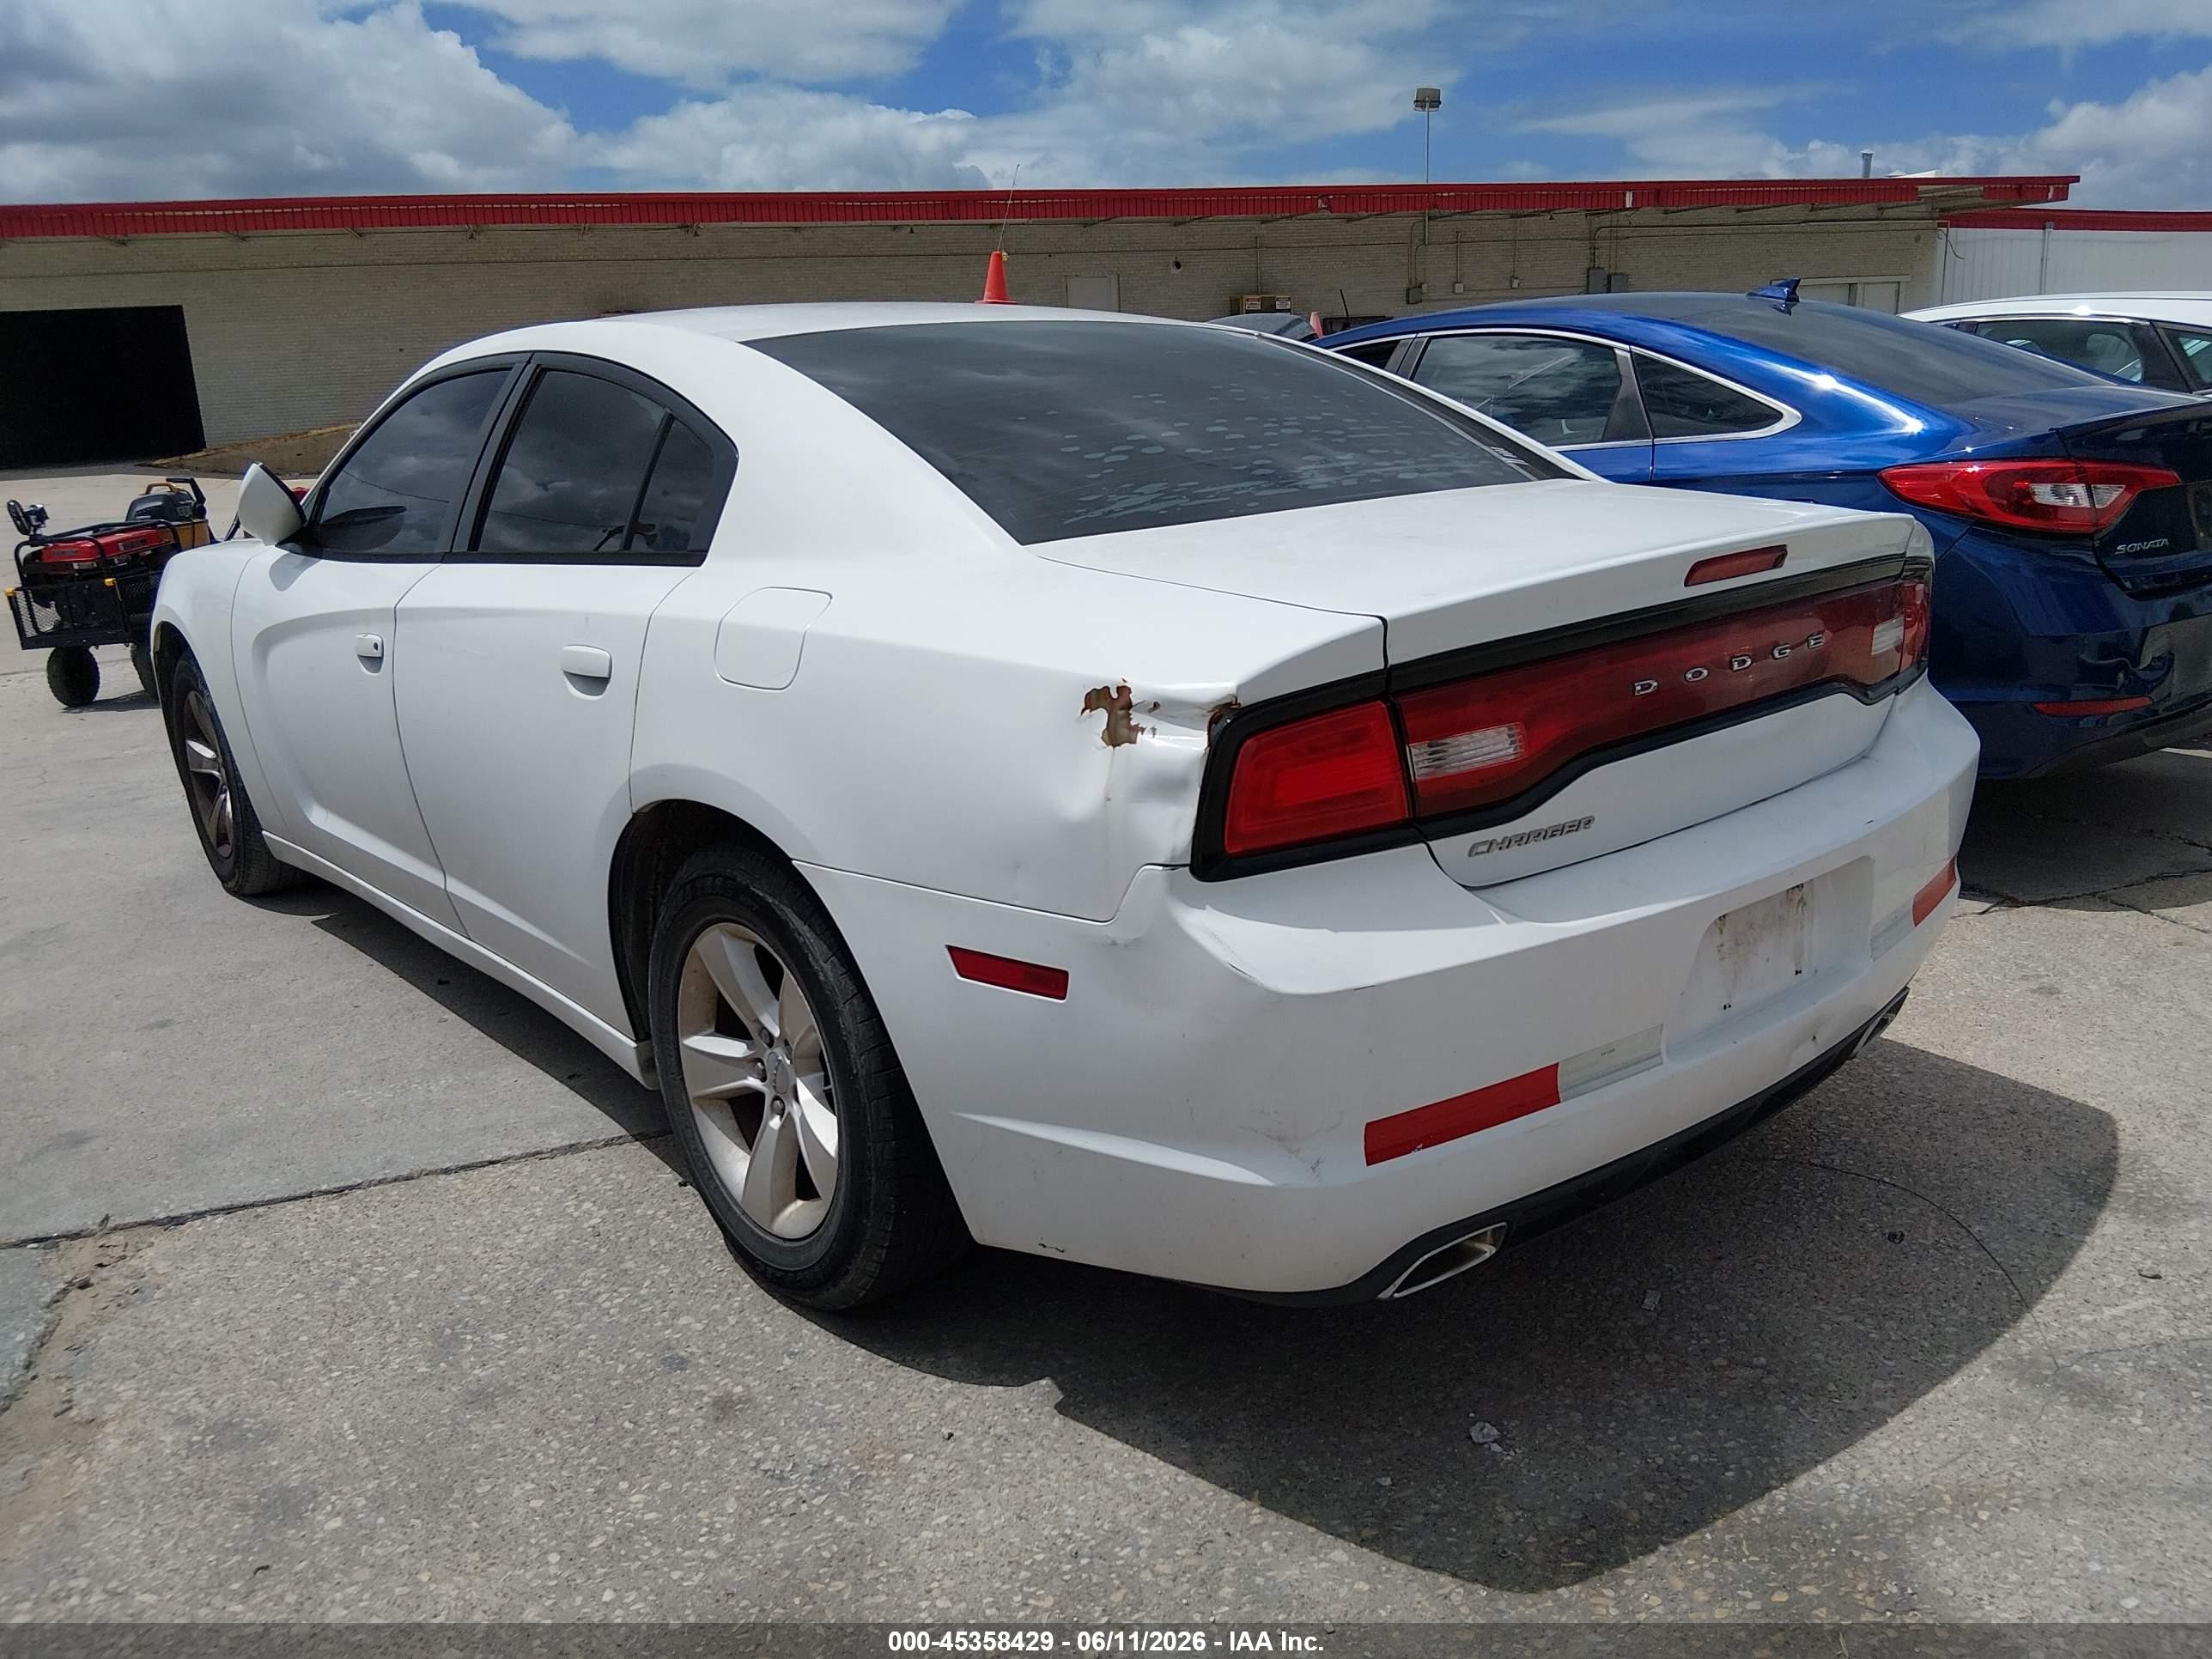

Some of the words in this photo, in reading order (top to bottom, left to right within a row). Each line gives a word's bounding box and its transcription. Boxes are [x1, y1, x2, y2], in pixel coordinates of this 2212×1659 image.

[2115, 538, 2169, 556] SONATA
[1633, 632, 1826, 696] DODGE
[1468, 816, 1595, 858] CHARGER
